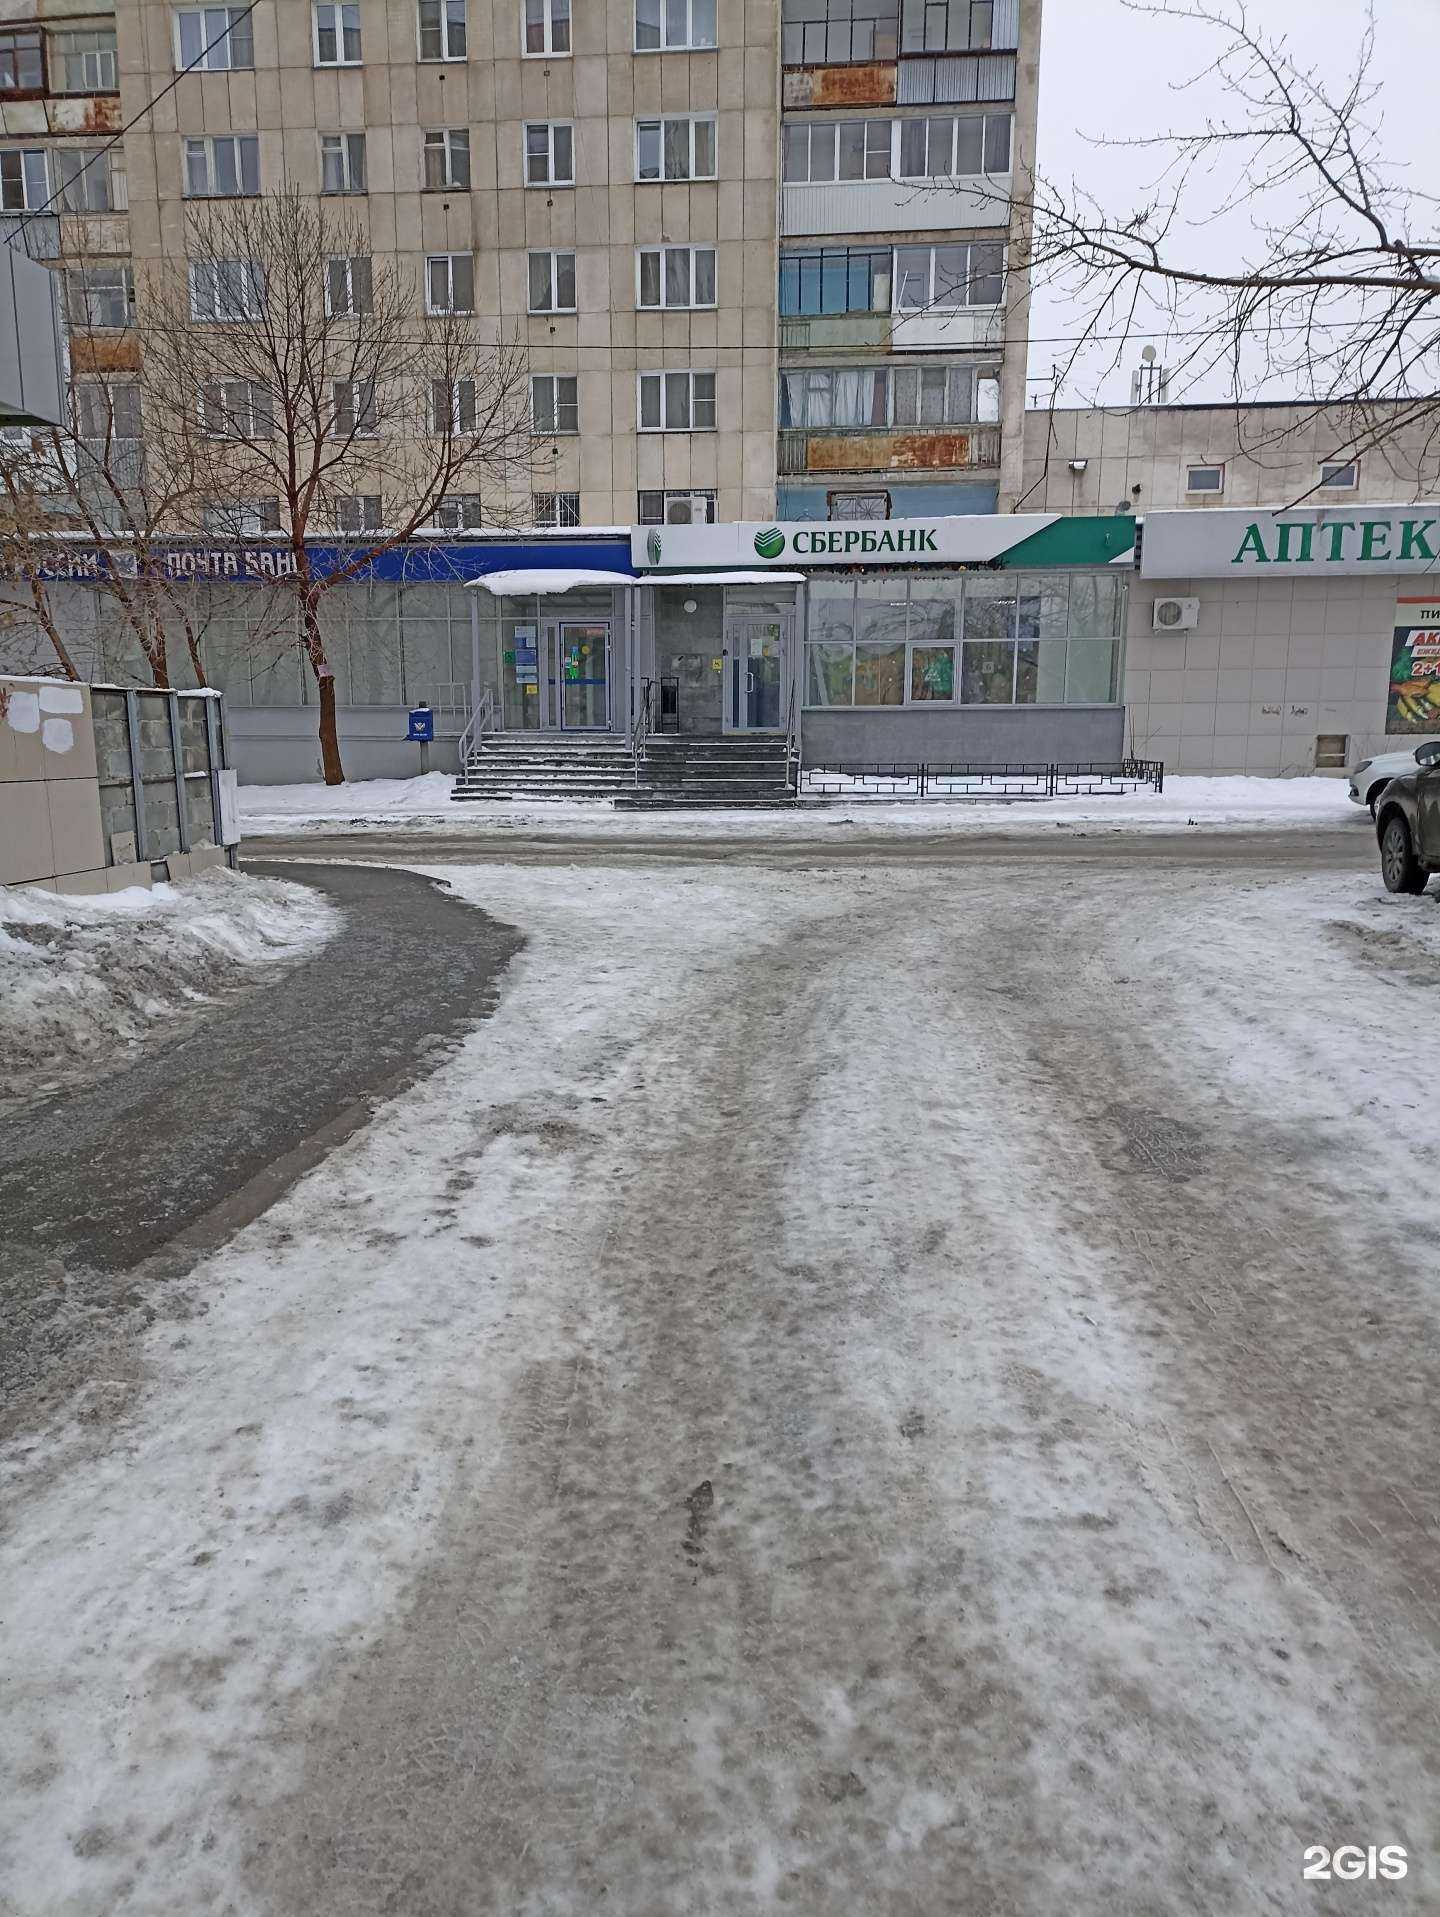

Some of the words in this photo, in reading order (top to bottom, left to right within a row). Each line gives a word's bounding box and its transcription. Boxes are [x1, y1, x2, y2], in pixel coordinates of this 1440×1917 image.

[792, 529, 938, 554] СБЕРБАНК
[1231, 520, 1437, 563] АПТЕК
[167, 552, 238, 577] ПОЧТА
[1413, 632, 1440, 646] АК
